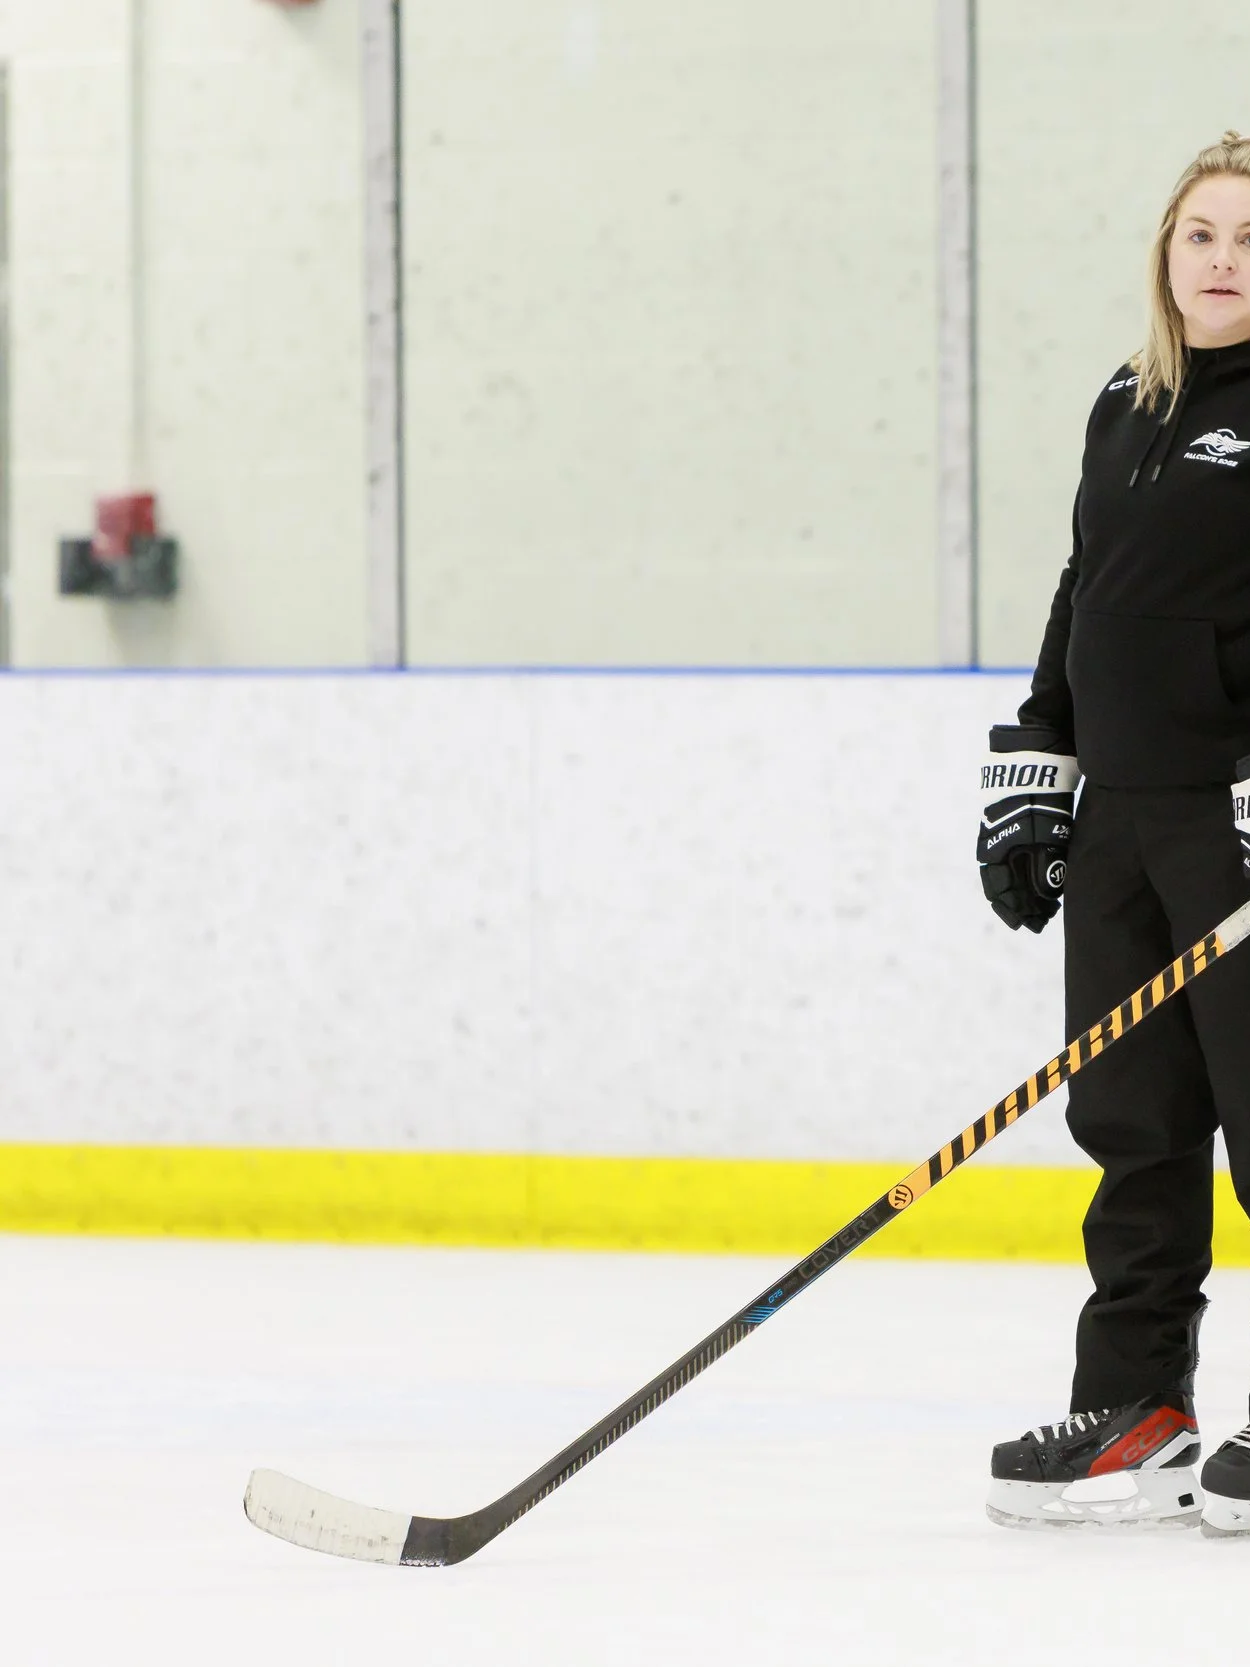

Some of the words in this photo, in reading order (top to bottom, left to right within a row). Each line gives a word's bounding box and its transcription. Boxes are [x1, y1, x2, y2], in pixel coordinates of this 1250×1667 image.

[1109, 375, 1140, 391] CC
[981, 764, 1059, 789] RRIOR
[987, 822, 1021, 850] ALPHA
[928, 931, 1222, 1188] WARRIOR
[798, 1207, 882, 1280] COVERT
